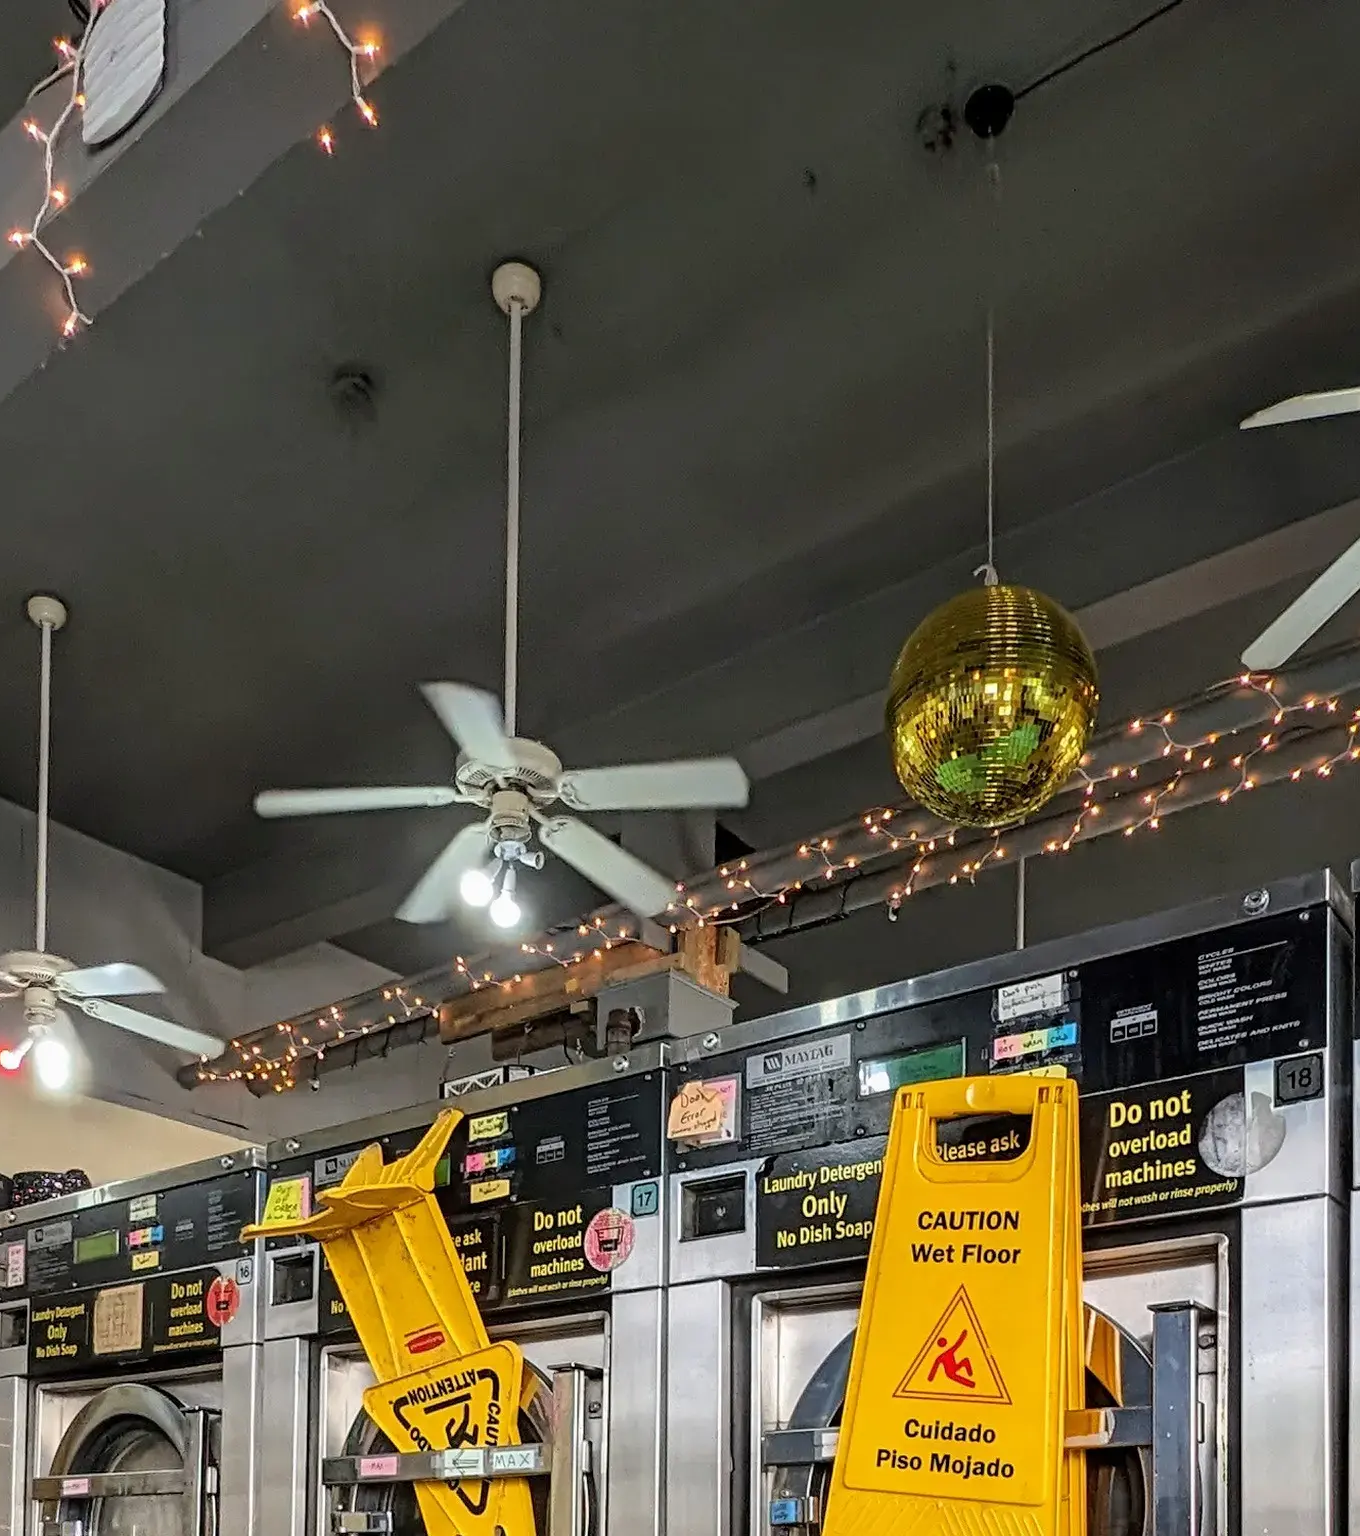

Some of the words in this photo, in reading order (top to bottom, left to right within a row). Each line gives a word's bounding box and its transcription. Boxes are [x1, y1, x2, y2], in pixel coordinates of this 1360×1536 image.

[1233, 979, 1273, 994] COLORS
[1255, 992, 1288, 1004] PRESS
[784, 1044, 833, 1066] MAYTAG
[1286, 1067, 1312, 1089] 18
[681, 1108, 706, 1124] Error
[1109, 1101, 1142, 1128] Do
[1150, 1089, 1192, 1121] not
[990, 1130, 1020, 1153] ask
[1108, 1124, 1191, 1158] overload
[764, 1170, 817, 1194] Laundry
[821, 1160, 883, 1183] Detergen
[1105, 1158, 1196, 1188] machines
[638, 1192, 653, 1207] 17
[802, 1191, 847, 1218] Only
[1101, 1198, 1117, 1209] will
[1118, 1196, 1134, 1207] not
[1134, 1191, 1158, 1204] wash
[1159, 1191, 1170, 1200] or
[1170, 1187, 1193, 1199] rinse
[1194, 1179, 1238, 1197] properly)
[534, 1212, 554, 1231] Do
[557, 1205, 582, 1226] not
[917, 1210, 1020, 1231] CAUTION
[463, 1230, 482, 1247] ask
[533, 1232, 582, 1254] overload
[776, 1231, 796, 1248] No
[800, 1223, 832, 1245] Dish
[835, 1219, 873, 1239] Soap
[911, 1244, 955, 1263] Wet
[962, 1244, 1021, 1265] Floor
[240, 1266, 250, 1278] 16
[530, 1257, 585, 1279] machines
[171, 1283, 185, 1299] Do
[186, 1279, 203, 1296] not
[170, 1303, 202, 1318] overload
[331, 1300, 343, 1314] No
[47, 1323, 67, 1341] Only
[168, 1322, 204, 1337] machines
[407, 1369, 477, 1406] ATTENTION
[485, 1402, 501, 1446] CAUT
[904, 1418, 996, 1444] Cuidado
[495, 1453, 530, 1467] MAX
[876, 1448, 922, 1471] Piso
[930, 1453, 1014, 1479] Mojado
